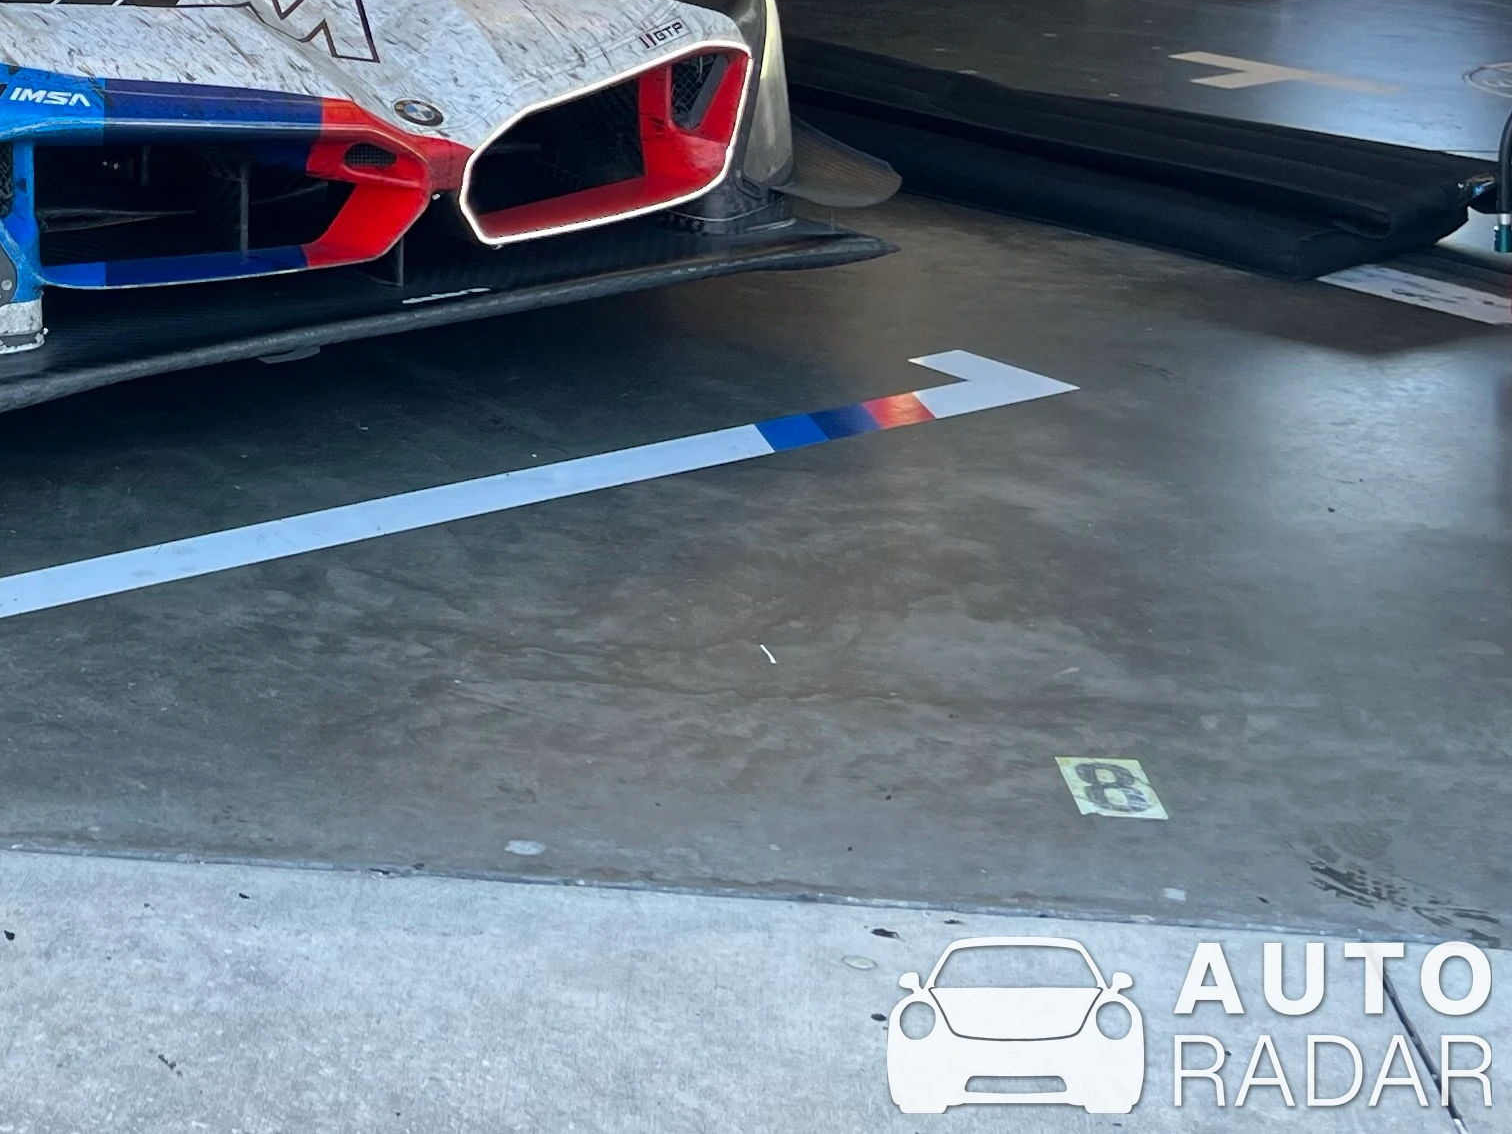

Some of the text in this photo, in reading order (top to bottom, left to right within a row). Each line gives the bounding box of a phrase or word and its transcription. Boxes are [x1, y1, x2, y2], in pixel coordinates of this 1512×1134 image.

[653, 21, 683, 42] GTP
[9, 87, 91, 107] IMSA
[1078, 761, 1155, 813] 8
